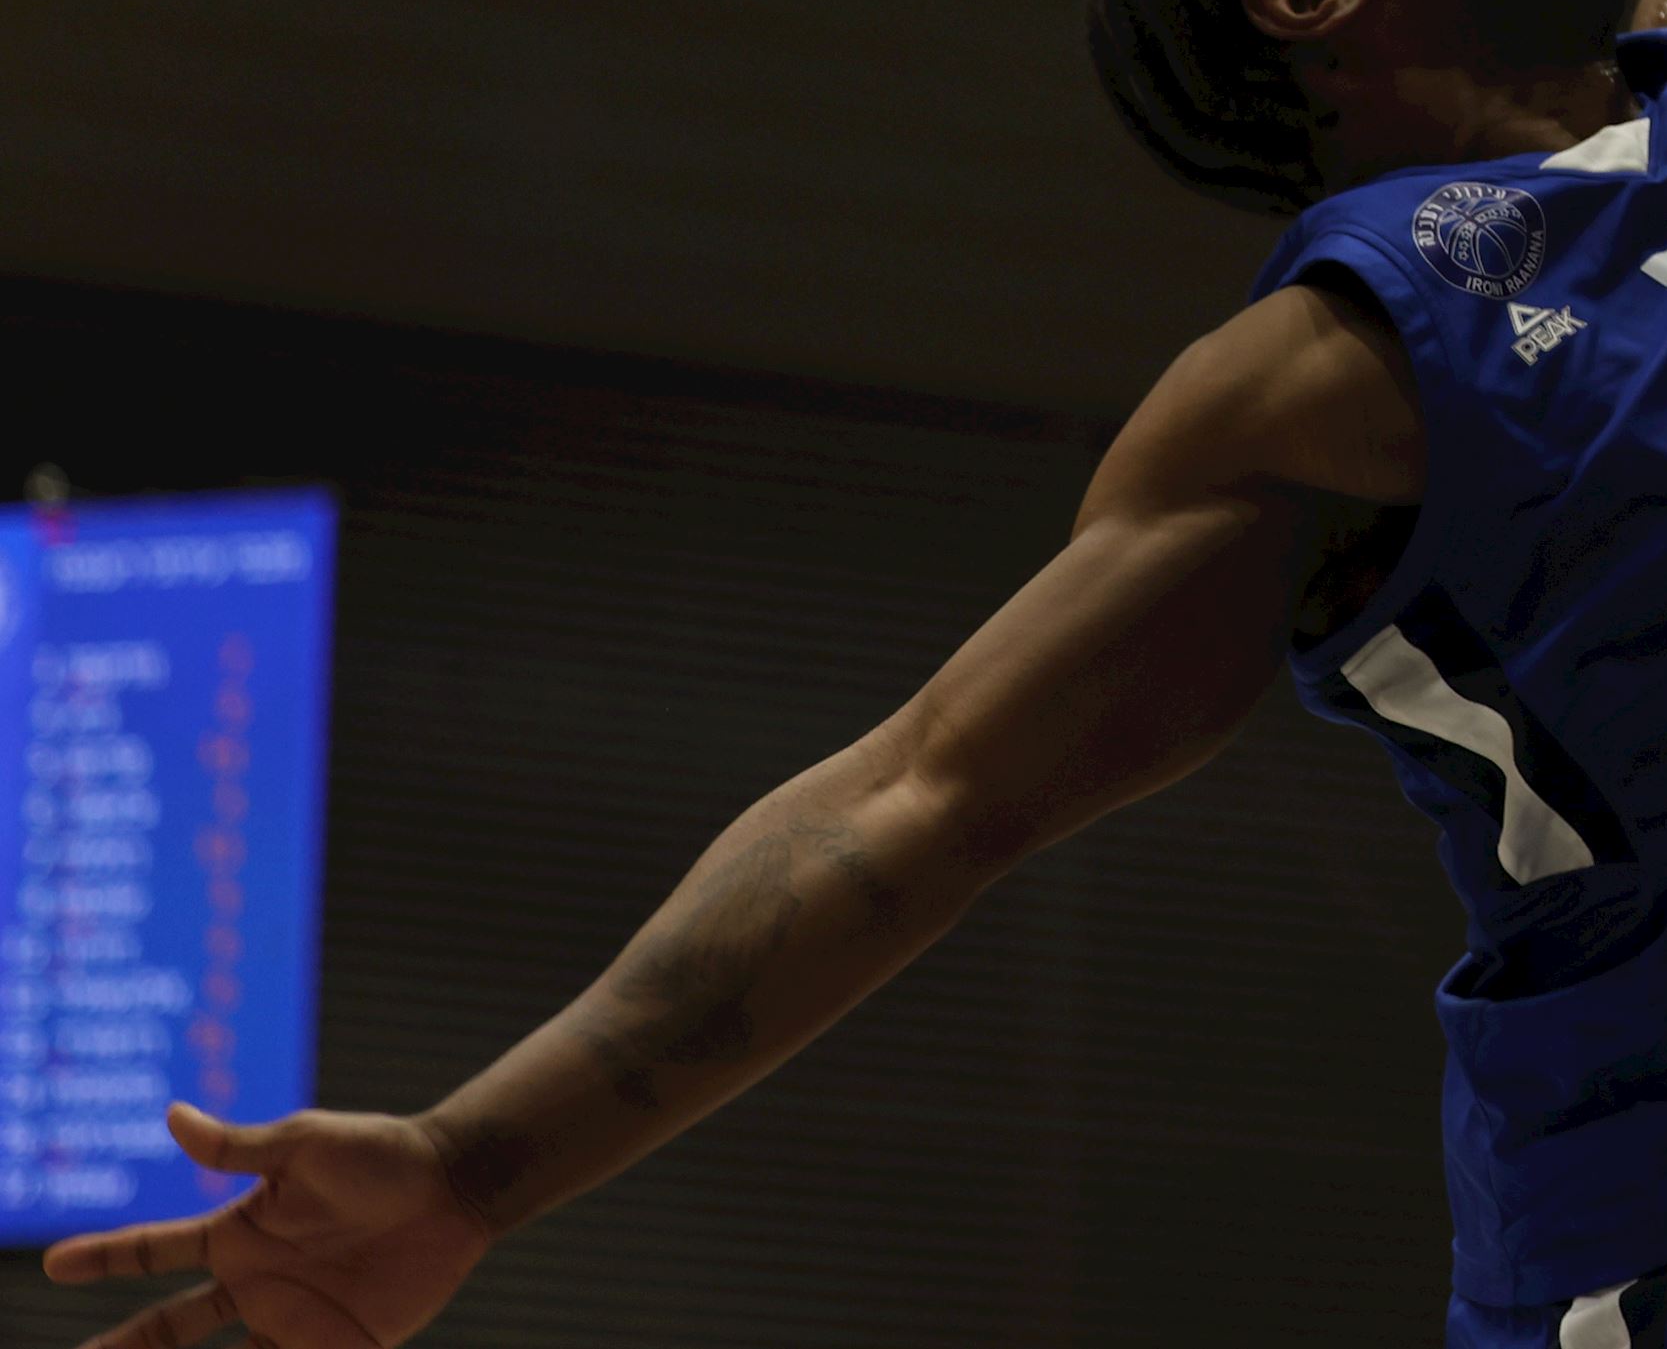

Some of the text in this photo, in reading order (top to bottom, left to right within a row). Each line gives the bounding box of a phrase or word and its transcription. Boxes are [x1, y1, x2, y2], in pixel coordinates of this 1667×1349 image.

[1465, 229, 1545, 297] IRONI RAANANA
[1510, 304, 1589, 367] PEAK
